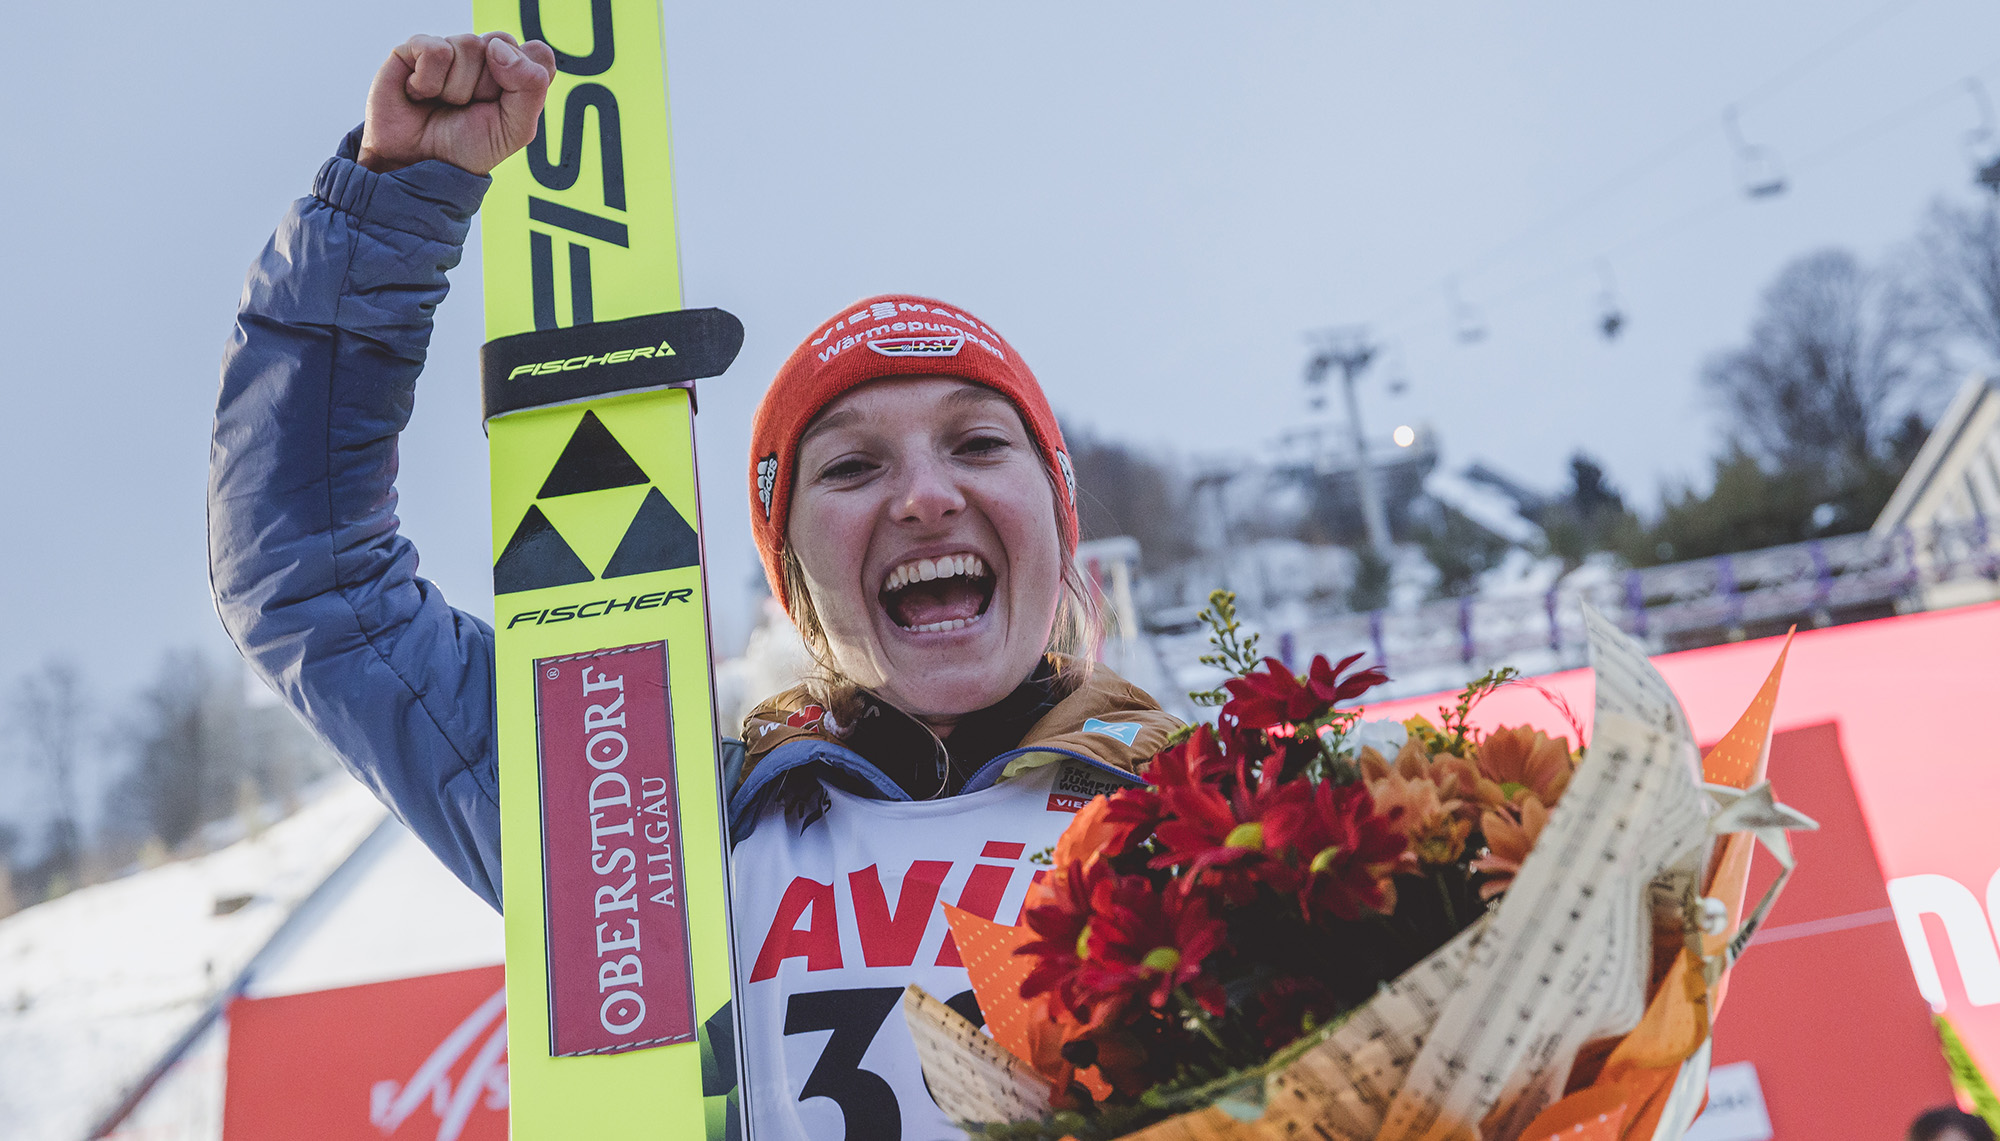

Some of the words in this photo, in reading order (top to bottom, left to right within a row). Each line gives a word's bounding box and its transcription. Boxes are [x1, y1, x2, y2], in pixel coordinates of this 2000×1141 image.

[508, 345, 656, 381] FISCHER
[818, 321, 1004, 363] Wärmepumpen
[506, 588, 693, 630] FISCHER
[1063, 766, 1090, 780] SKI
[581, 665, 646, 1035] OBERSTDORF
[638, 776, 675, 908] ALLGÄU
[749, 840, 1056, 984] AVi
[784, 986, 985, 1141] 3
